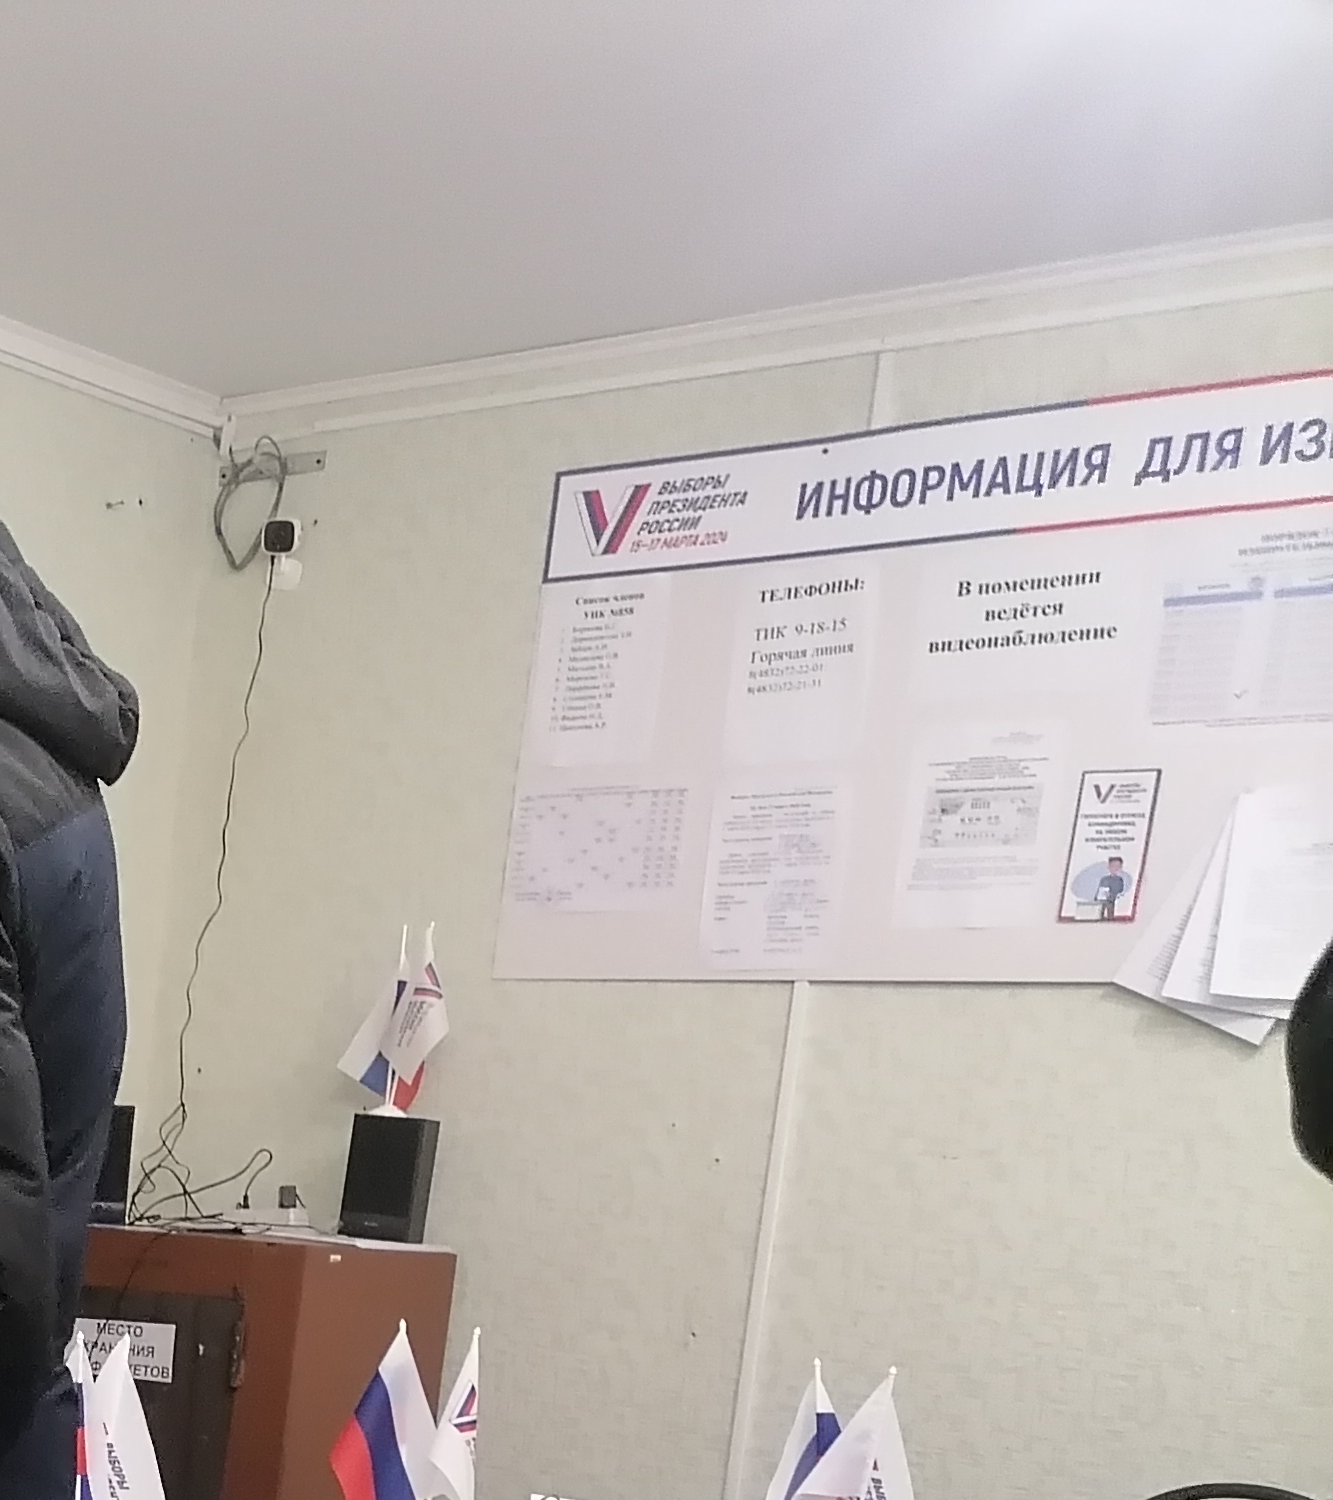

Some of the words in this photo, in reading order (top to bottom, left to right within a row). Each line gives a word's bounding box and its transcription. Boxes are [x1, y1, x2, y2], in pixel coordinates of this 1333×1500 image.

[795, 441, 1112, 521] ИНФОРМАЦИЯ
[1134, 426, 1247, 488] ДЛЯ
[1258, 417, 1333, 467] ИЗ
[657, 473, 730, 496] ВЫБОРЫ
[646, 491, 748, 516] ПРЕЗИДЕНТА
[636, 515, 702, 536] РОССИИ
[661, 533, 700, 550] МАРТА
[700, 530, 728, 547] 2024
[759, 578, 865, 604] ТЕЛЕФОНЫ:
[957, 580, 972, 598] В
[978, 570, 1101, 596] помещении
[985, 601, 1064, 622] ведётся
[755, 625, 787, 641] ТИК
[795, 617, 847, 636] 9-18-15
[928, 624, 1118, 654] видеонаблюдение
[751, 648, 807, 666] Горячая
[812, 643, 854, 659] линия
[96, 1321, 144, 1338] МЕСТО
